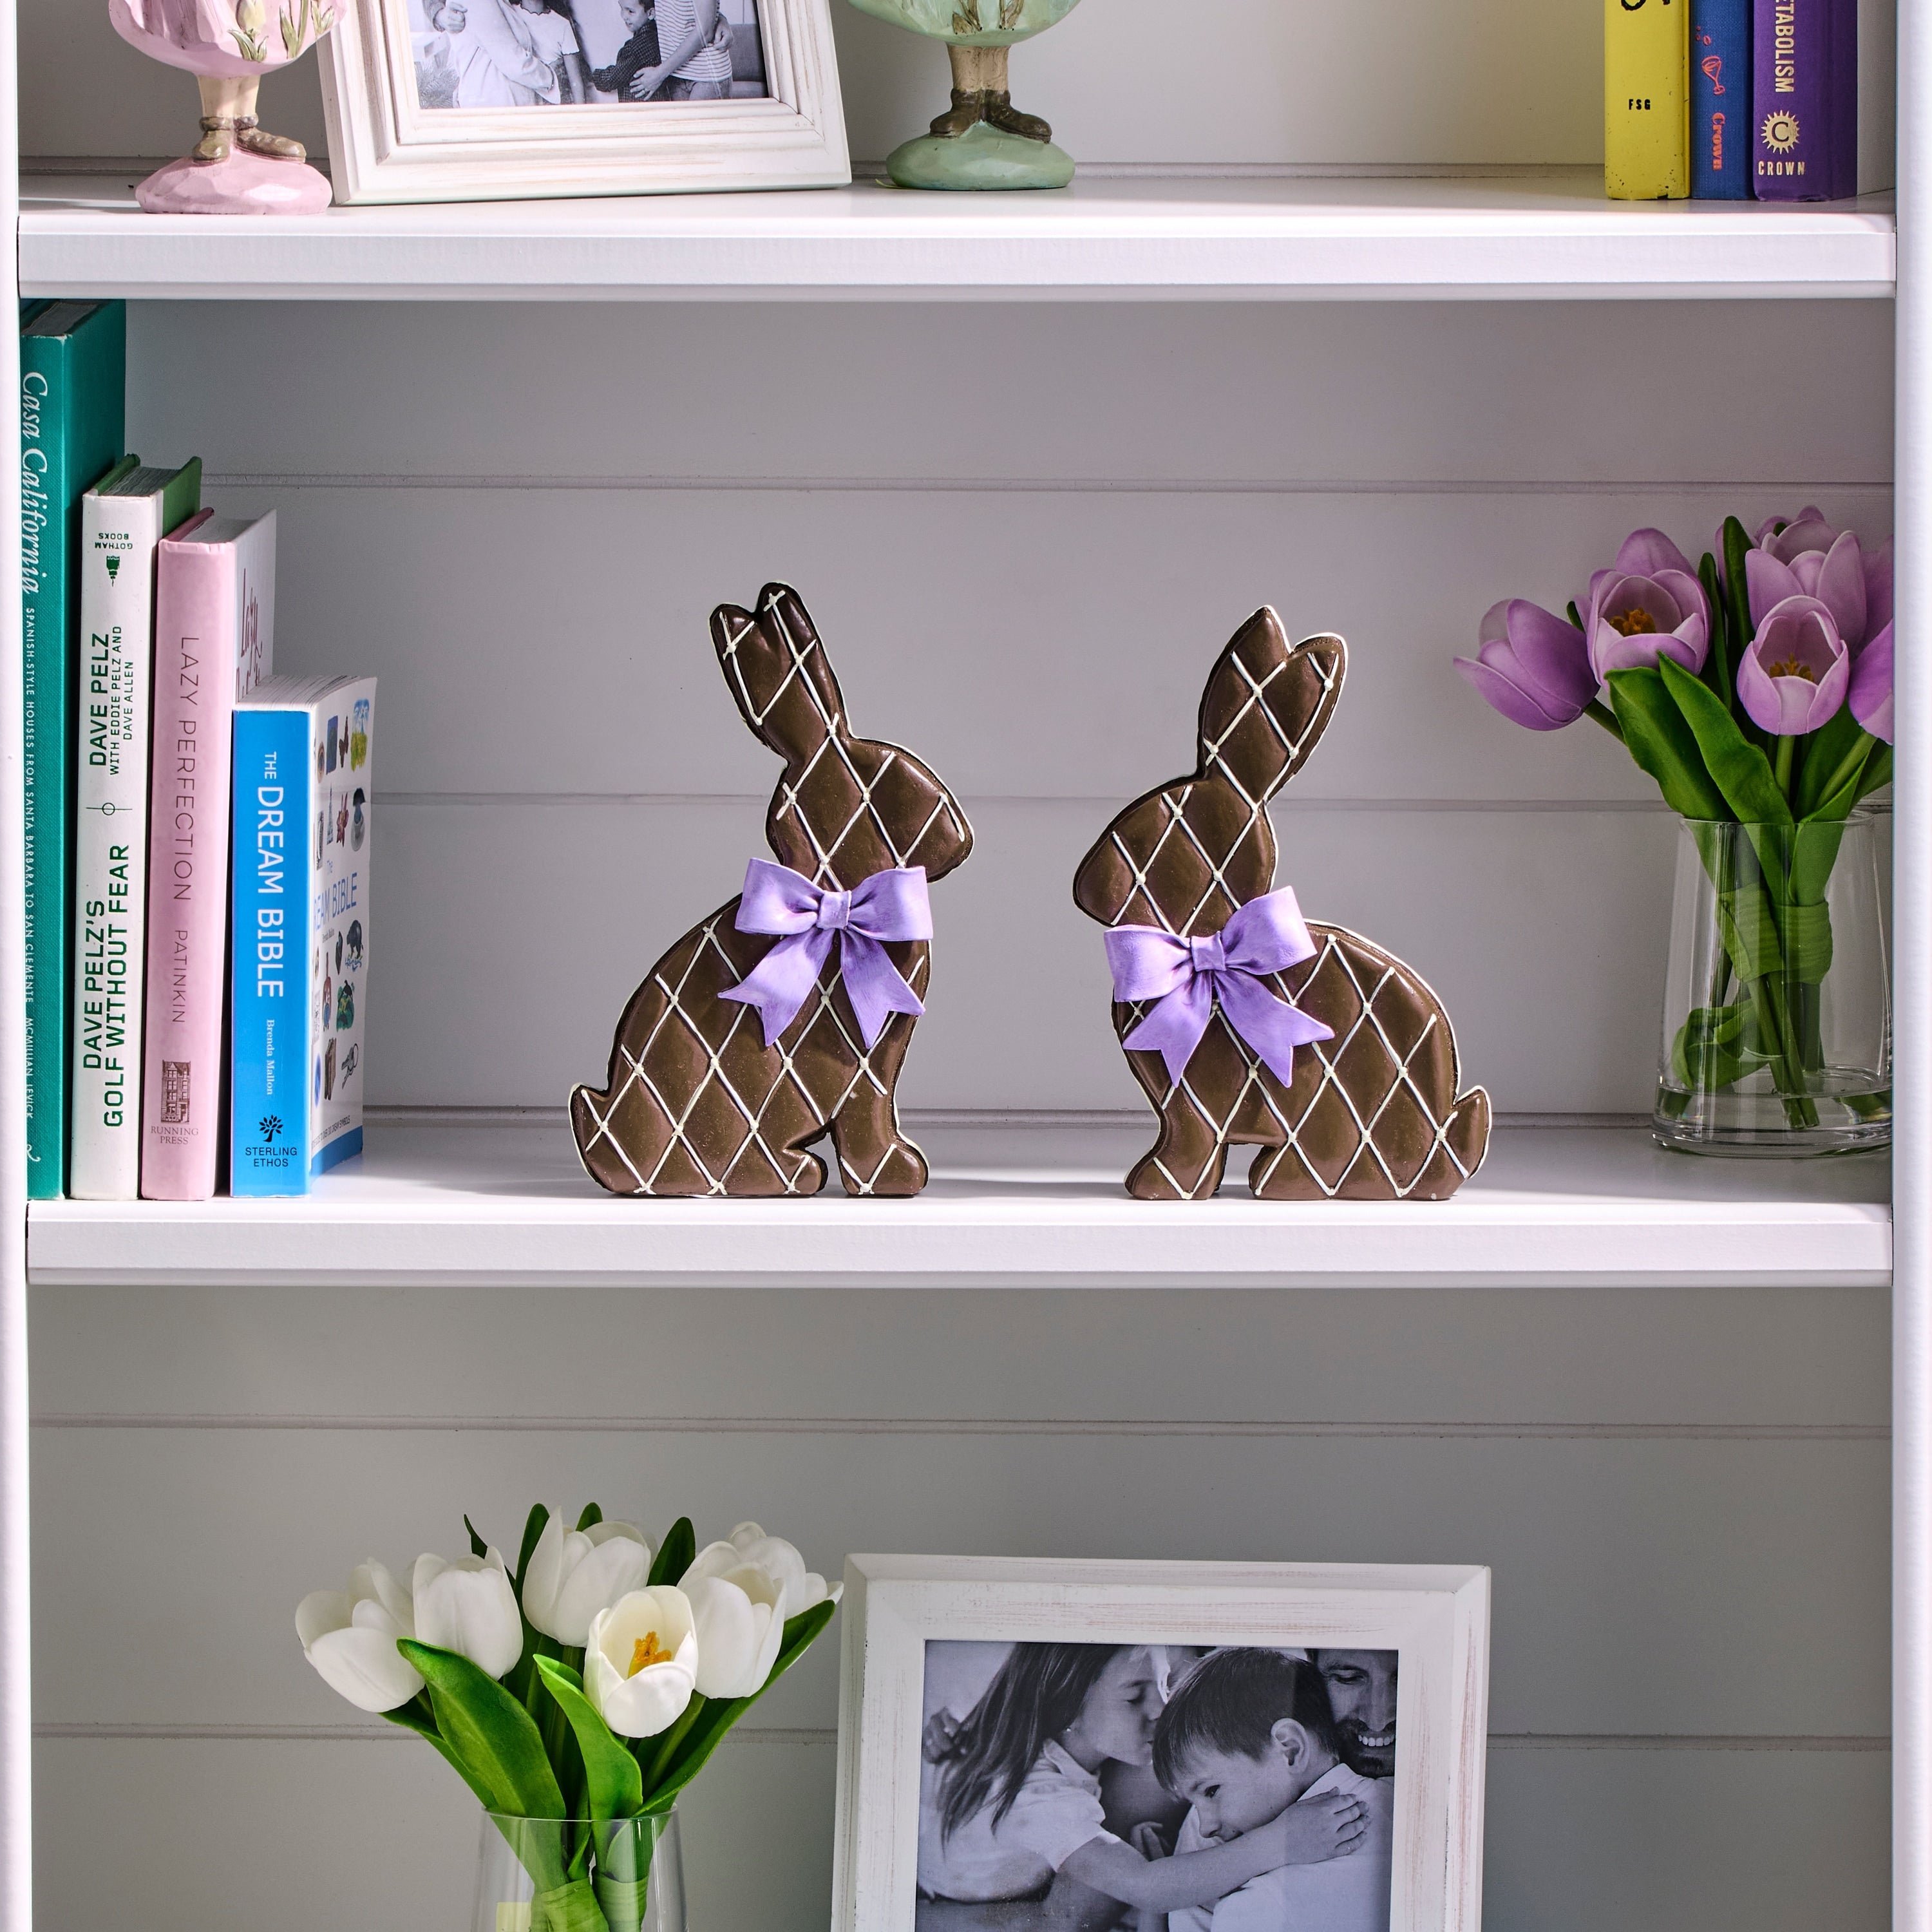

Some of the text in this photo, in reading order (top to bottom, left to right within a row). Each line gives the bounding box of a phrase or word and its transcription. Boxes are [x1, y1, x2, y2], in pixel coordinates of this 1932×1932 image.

[1775, 0, 1794, 93] TABOLISM
[1629, 99, 1651, 110] FSG
[1712, 112, 1725, 171] Crown
[1758, 161, 1805, 176] CROWN
[22, 372, 48, 594] Casa California
[89, 633, 109, 766] DAVE PELZ
[110, 626, 122, 775] WITH EDDIE PELZ AND
[123, 661, 134, 740] DAVE ALLEN
[24, 607, 35, 1003] SPANISH-STYLE HOUSES FROM SANTA BARBARA TO SAN CLEMENTE
[173, 638, 199, 901] LAZY PERFECTION
[258, 751, 284, 998] THE DREAM BIBLE
[332, 872, 357, 918] BIBLE
[83, 900, 104, 1068] DAVE PELZ'S
[104, 845, 129, 1127] GOLF WITHOUT FEAR
[172, 929, 189, 1023] PATINKIN
[267, 1019, 275, 1095] Brenda Mallon
[151, 1126, 199, 1136] RUNNING
[160, 1135, 189, 1145] PRESS
[245, 1147, 298, 1156] STERLING
[254, 1159, 289, 1167] ETHOS
